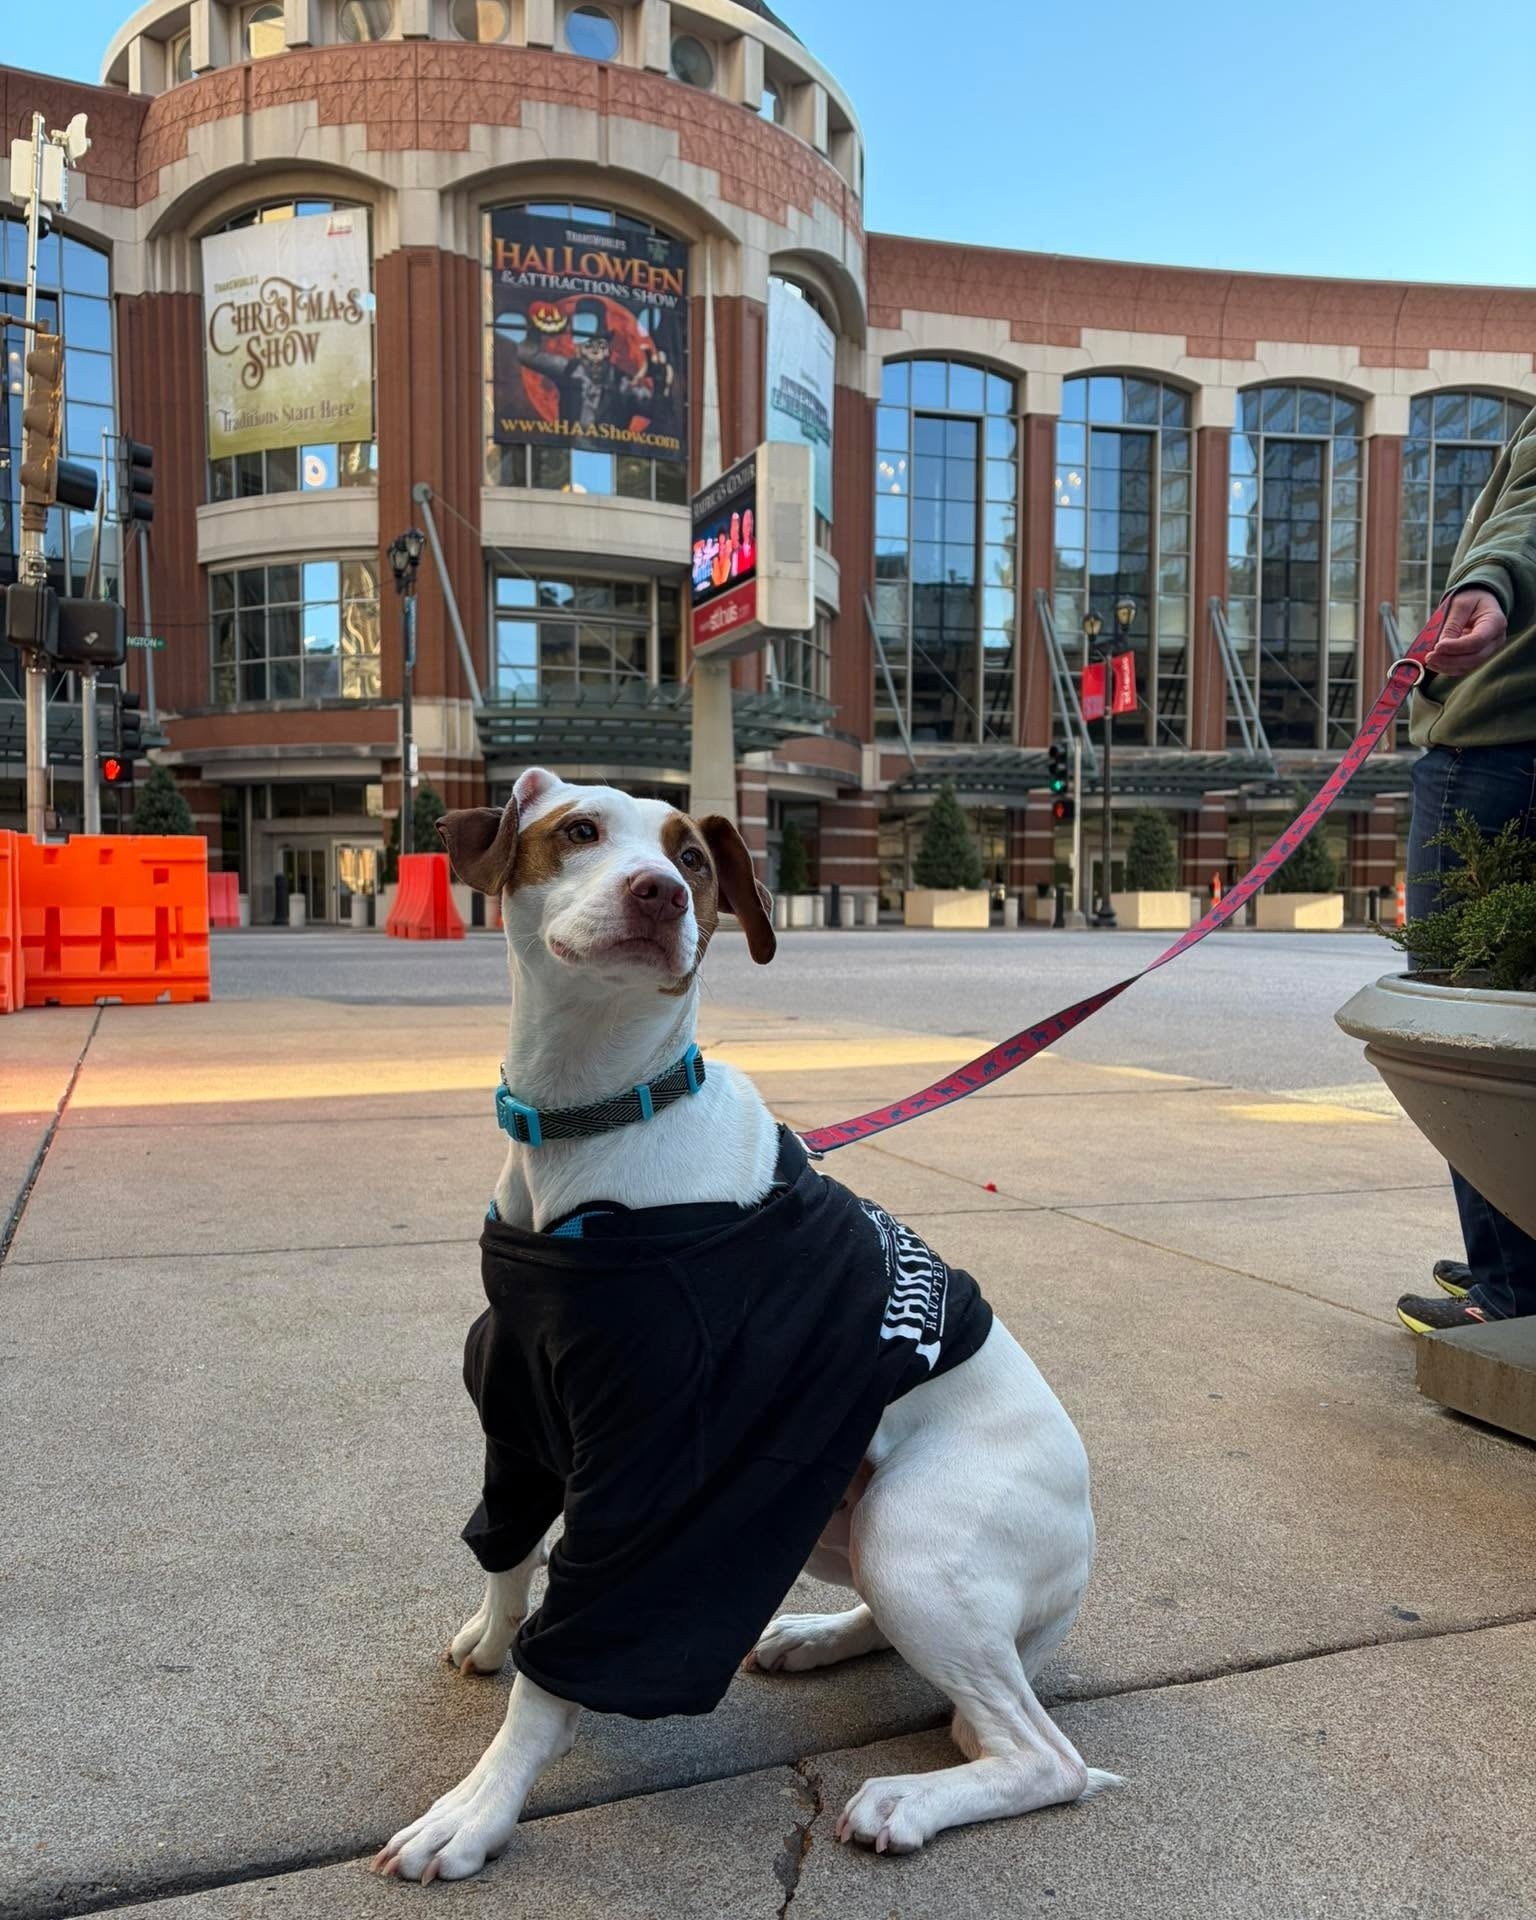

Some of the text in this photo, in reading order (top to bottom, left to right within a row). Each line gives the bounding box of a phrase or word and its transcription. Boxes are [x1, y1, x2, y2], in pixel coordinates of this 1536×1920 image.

[494, 237, 685, 297] HALLOWEEN
[516, 271, 631, 298] ATTRACTIONS
[632, 287, 679, 309] SHOW
[241, 330, 321, 391] SHOW
[216, 399, 355, 433] Traditions Start Here
